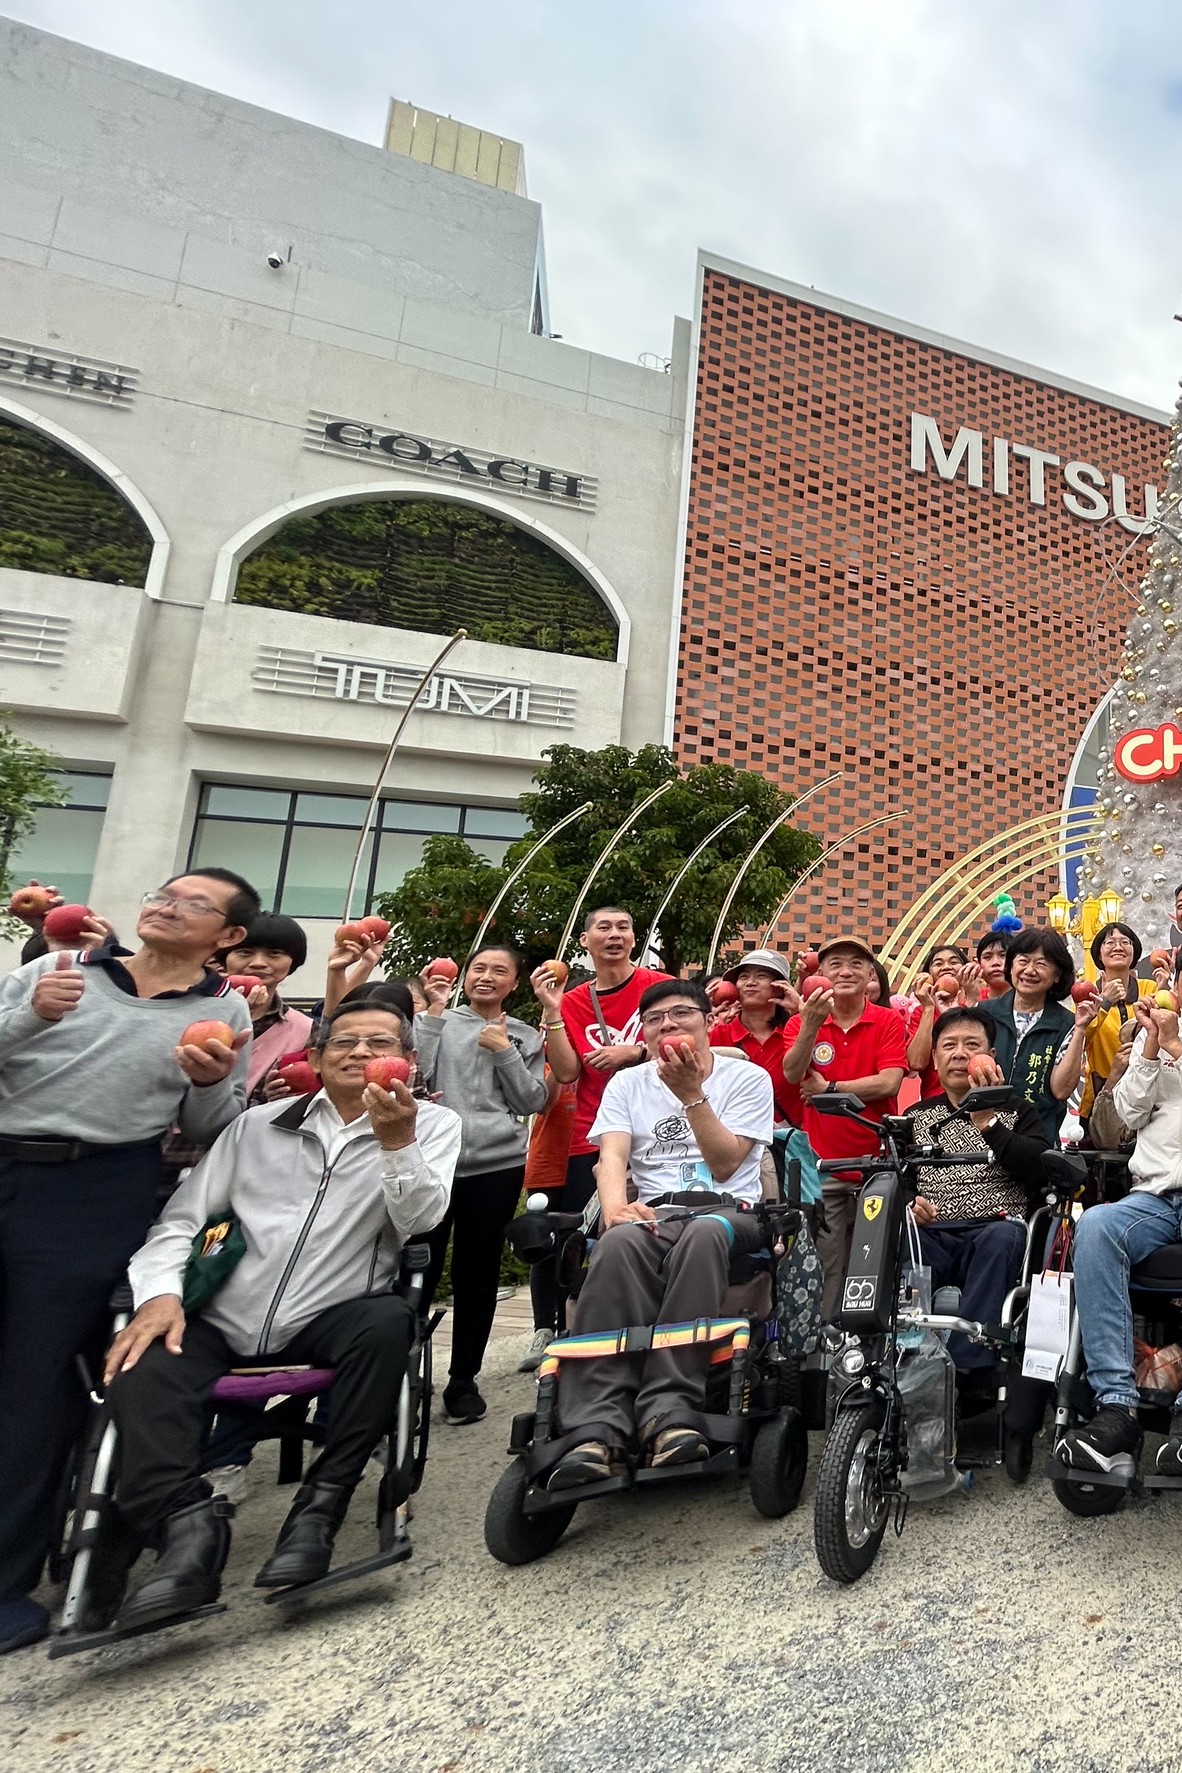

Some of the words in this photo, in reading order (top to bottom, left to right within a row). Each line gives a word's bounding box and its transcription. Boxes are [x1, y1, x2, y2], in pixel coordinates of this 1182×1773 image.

[325, 422, 582, 498] COACH
[911, 412, 1159, 535] MITSU
[313, 650, 531, 721] TUMI
[1025, 1053, 1042, 1104] 郭乃文
